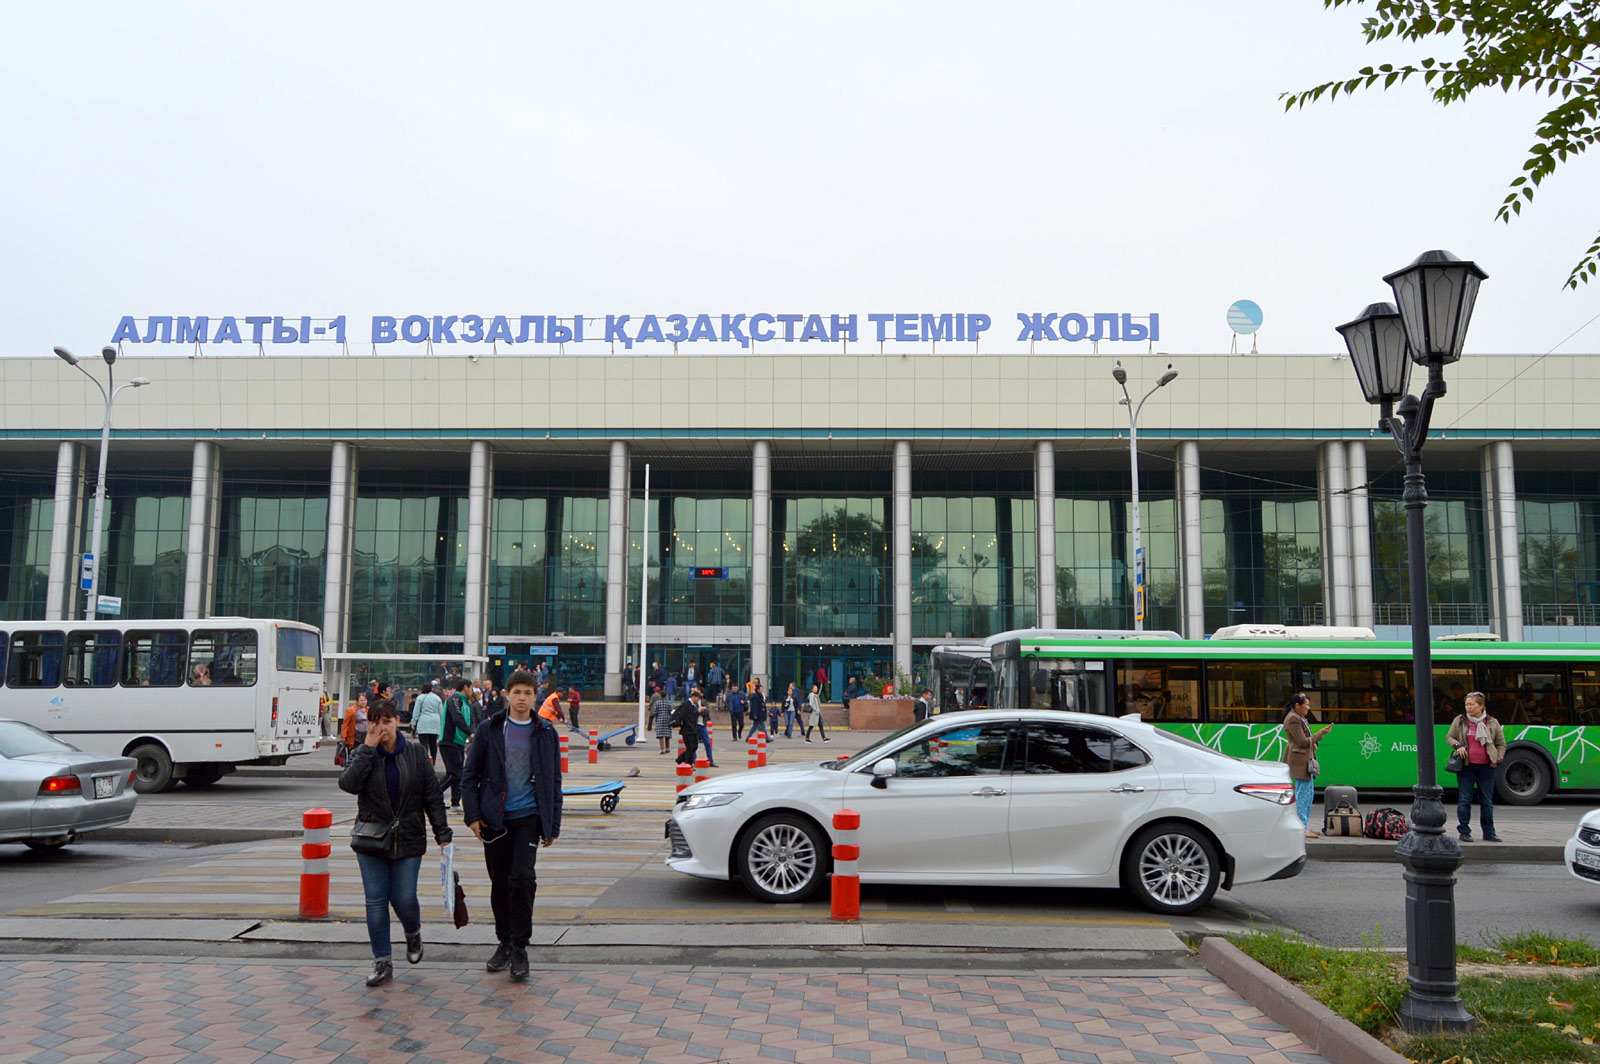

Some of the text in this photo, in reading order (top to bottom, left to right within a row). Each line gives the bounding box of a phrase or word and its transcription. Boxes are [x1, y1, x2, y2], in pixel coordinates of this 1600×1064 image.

[111, 312, 1160, 349] АЛМАТЫ-1 ВОКЗАЛЫ ҚАЗАҚСТАН ТЕМІР ЖОЛЫ
[1391, 741, 1418, 752] Alma
